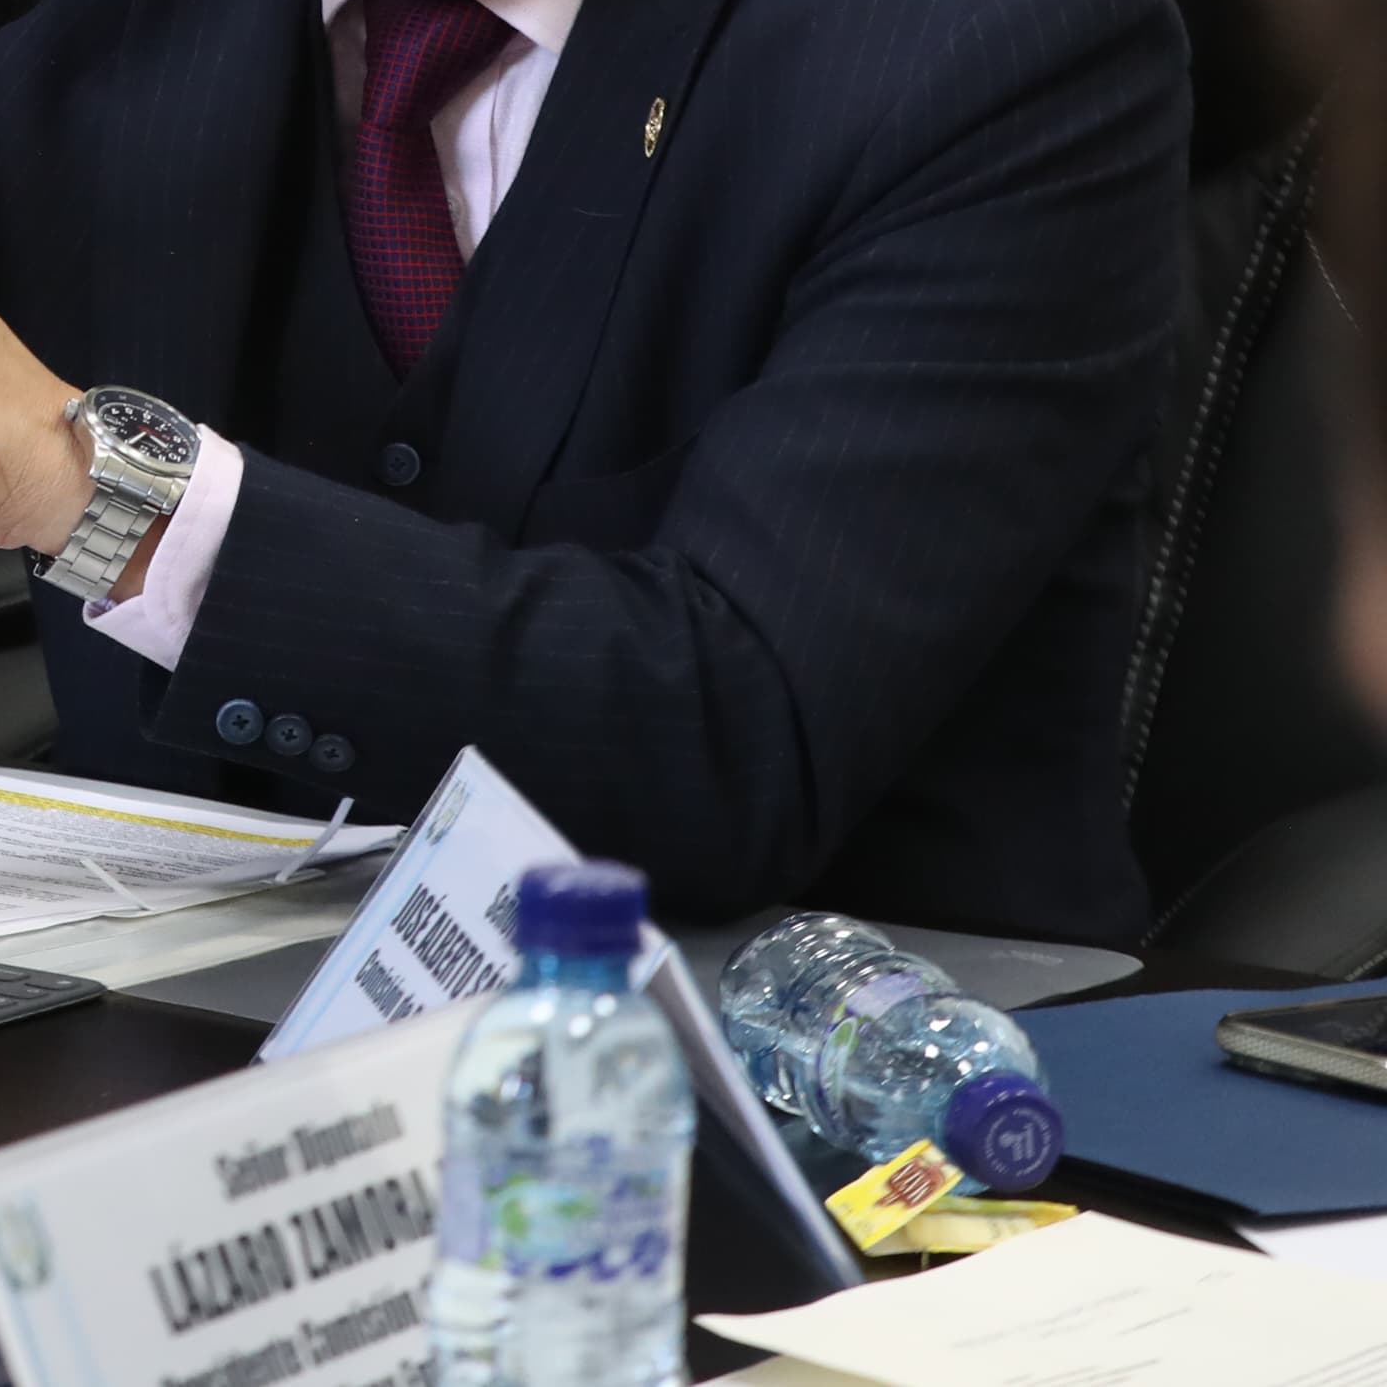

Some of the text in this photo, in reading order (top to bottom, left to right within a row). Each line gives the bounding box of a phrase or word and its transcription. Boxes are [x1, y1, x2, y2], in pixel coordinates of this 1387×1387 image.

[390, 882, 448, 948] JOSÉ
[413, 910, 485, 1000] ALBERTO
[148, 1221, 295, 1335] LÁZARO
